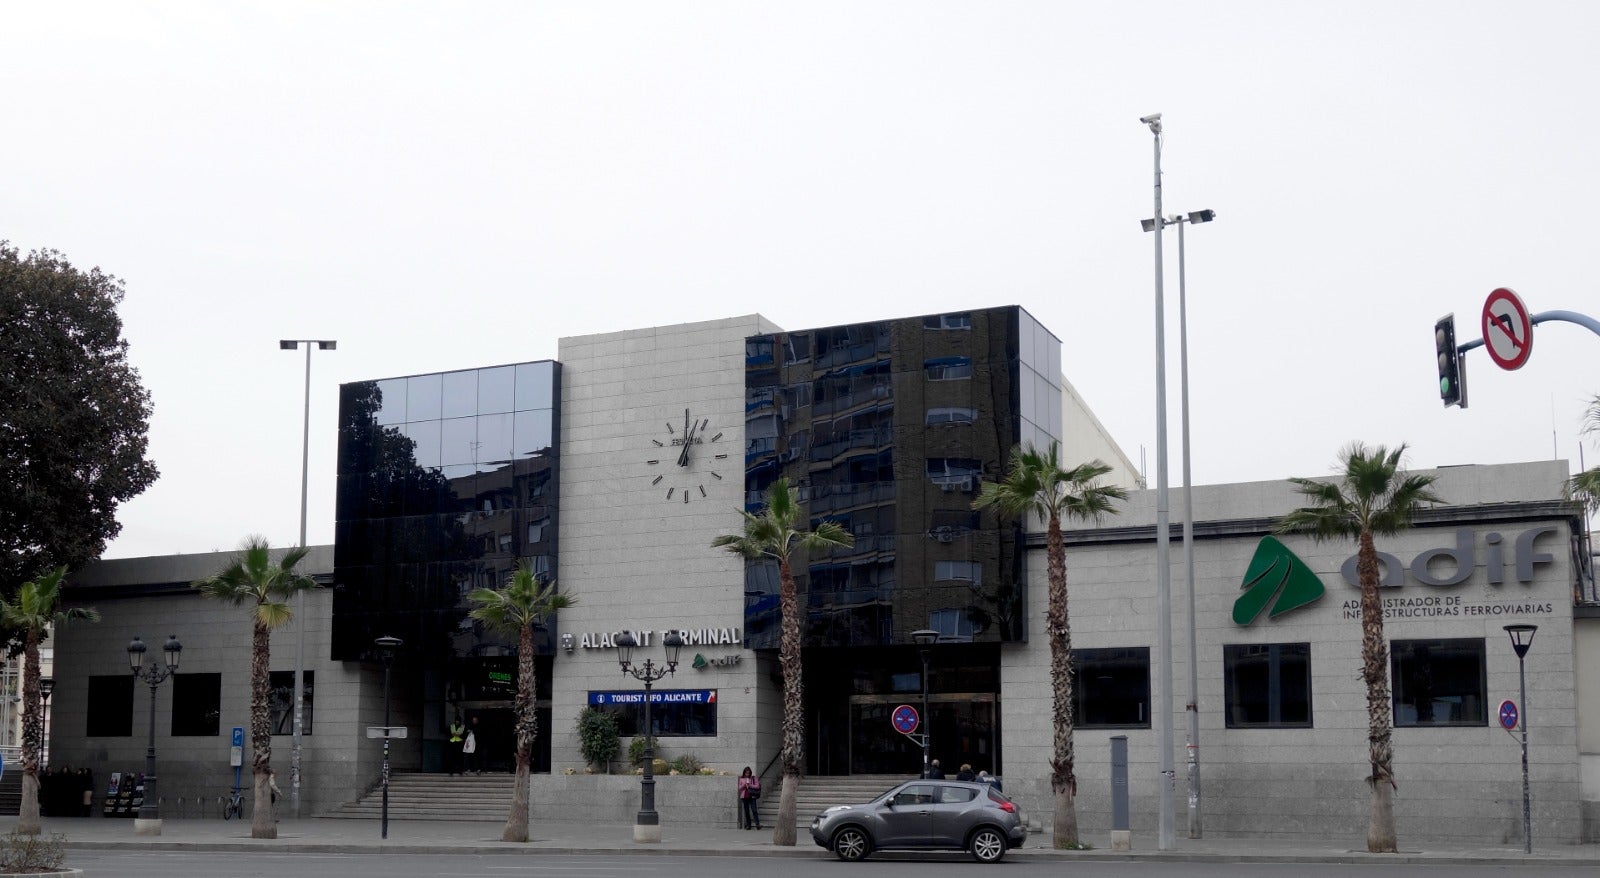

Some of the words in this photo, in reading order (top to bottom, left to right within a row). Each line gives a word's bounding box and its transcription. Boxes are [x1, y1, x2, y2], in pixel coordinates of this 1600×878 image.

[1341, 526, 1558, 588] adif
[1343, 597, 1441, 610] ADISTRADOR
[1446, 596, 1461, 606] DE
[1343, 606, 1459, 620] INFSTRUCTURAS
[1464, 603, 1553, 616] FERROVIARIAS
[581, 631, 652, 648] ALACNT
[659, 628, 740, 646] TRMINAL
[611, 694, 642, 703] TOURIST
[664, 692, 702, 702] ALICANTE
[234, 729, 241, 738] P
